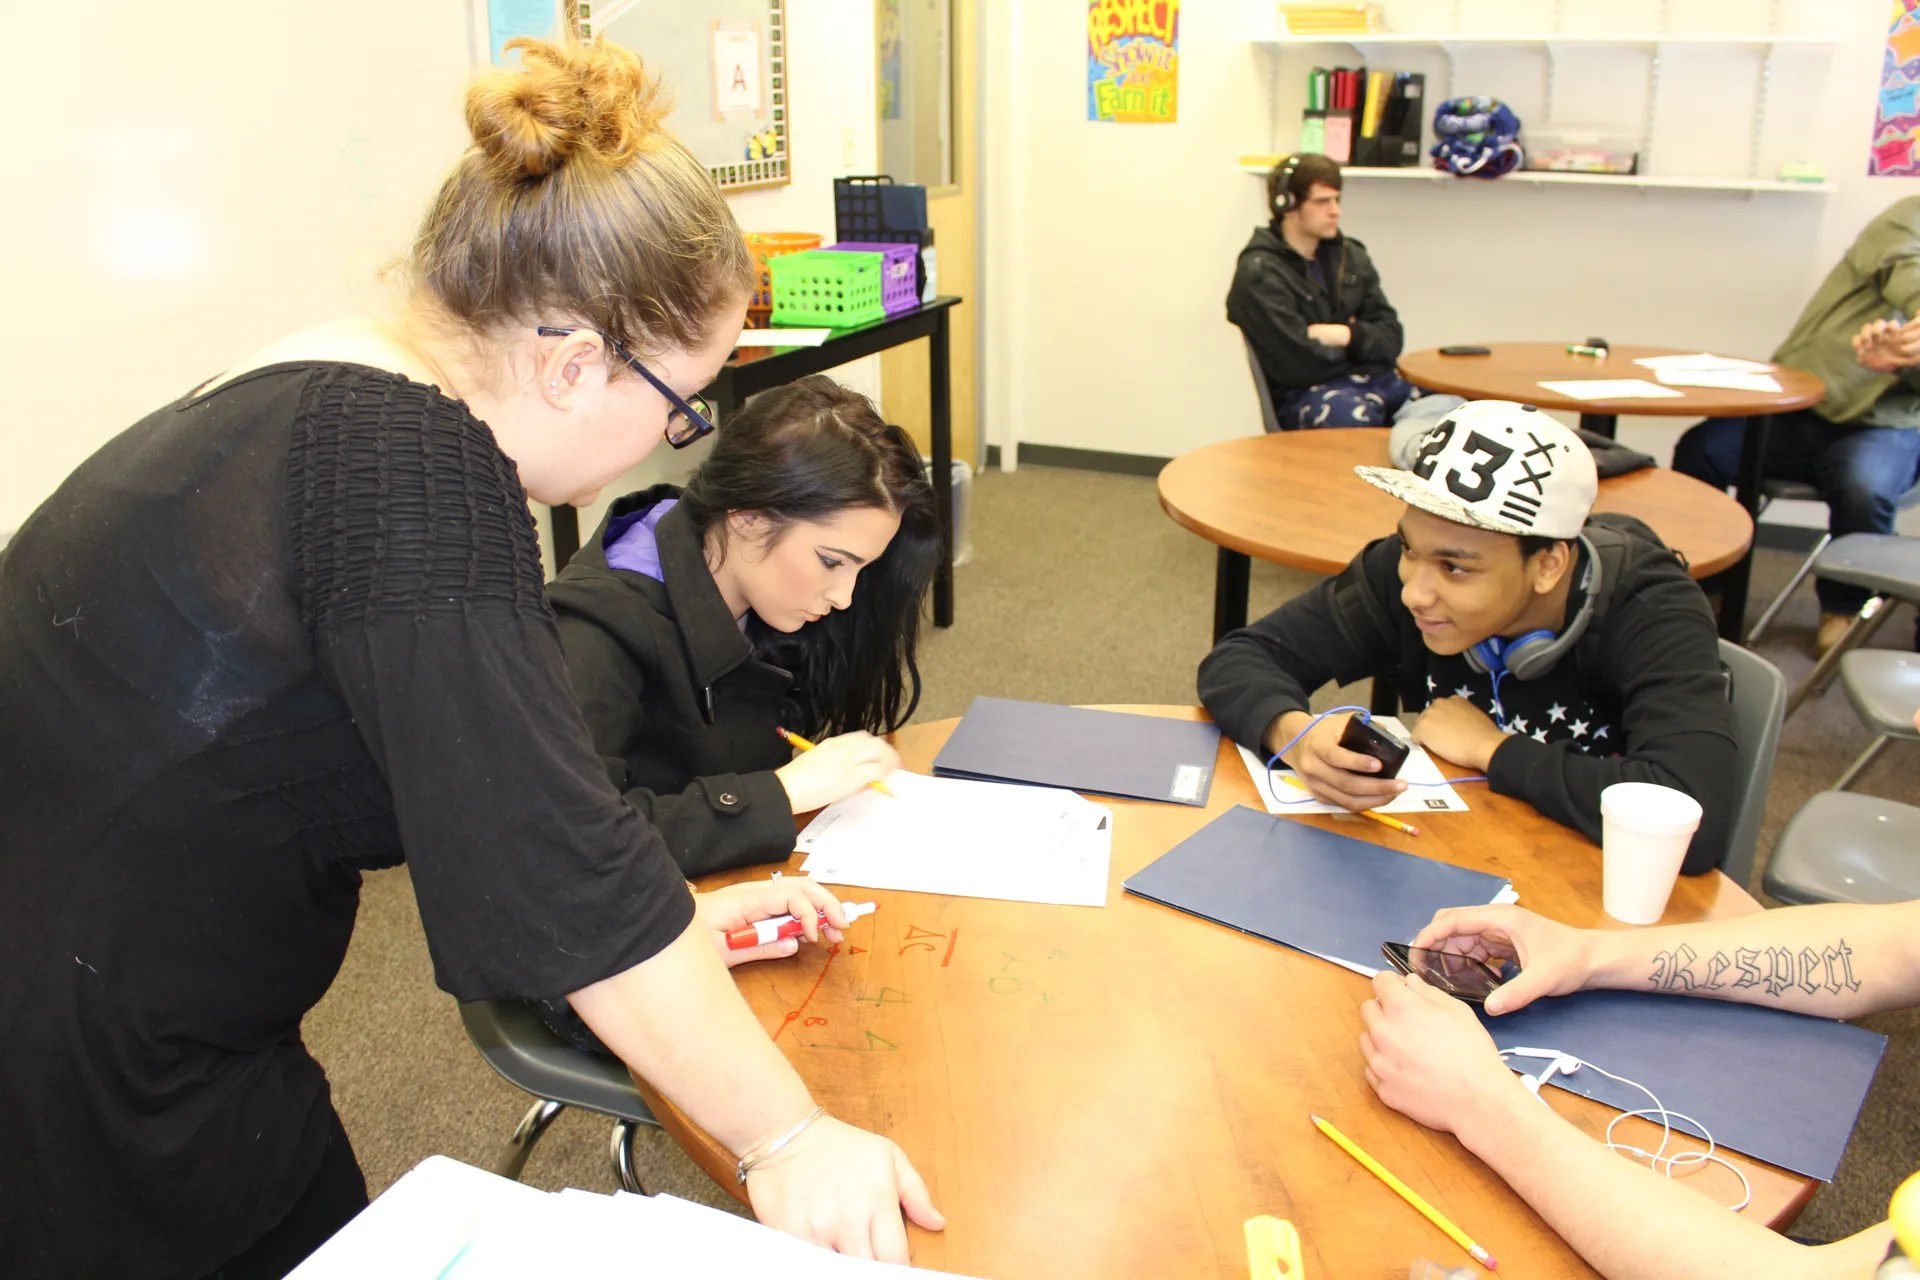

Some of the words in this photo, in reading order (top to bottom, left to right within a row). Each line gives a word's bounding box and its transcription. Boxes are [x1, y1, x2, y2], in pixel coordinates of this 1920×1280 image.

[730, 63, 747, 91] A
[1095, 81, 1145, 119] Earn
[1151, 86, 1170, 116] it
[1412, 418, 1515, 503] 23
[1648, 938, 1862, 997] Respect
